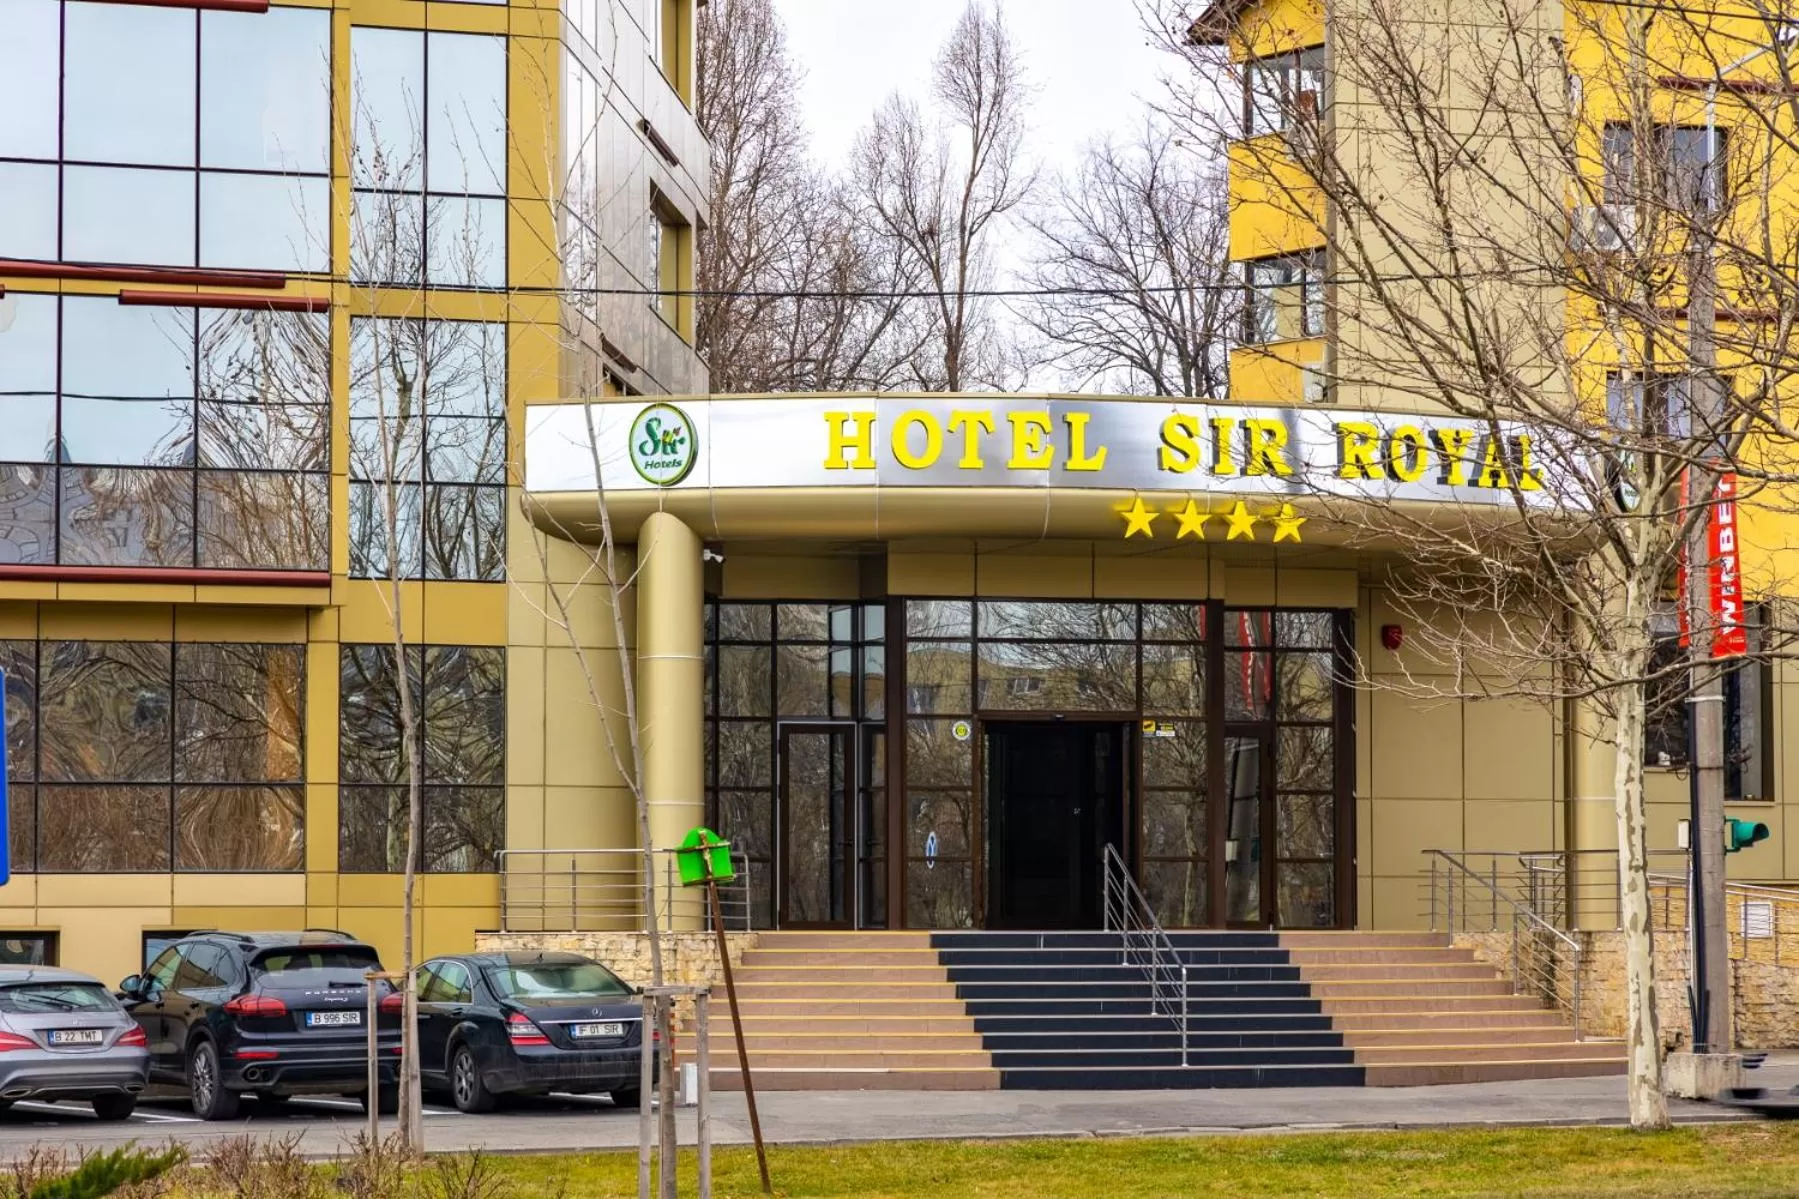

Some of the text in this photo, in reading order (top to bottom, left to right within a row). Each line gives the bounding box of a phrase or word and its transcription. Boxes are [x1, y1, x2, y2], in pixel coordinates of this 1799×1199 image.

[823, 409, 1544, 491] HOTEL SIR ROYAL
[644, 459, 683, 469] Hotels
[314, 1013, 321, 1024] B
[342, 1012, 358, 1023] SIR
[64, 1031, 76, 1041] 22
[80, 1030, 97, 1041] TMT
